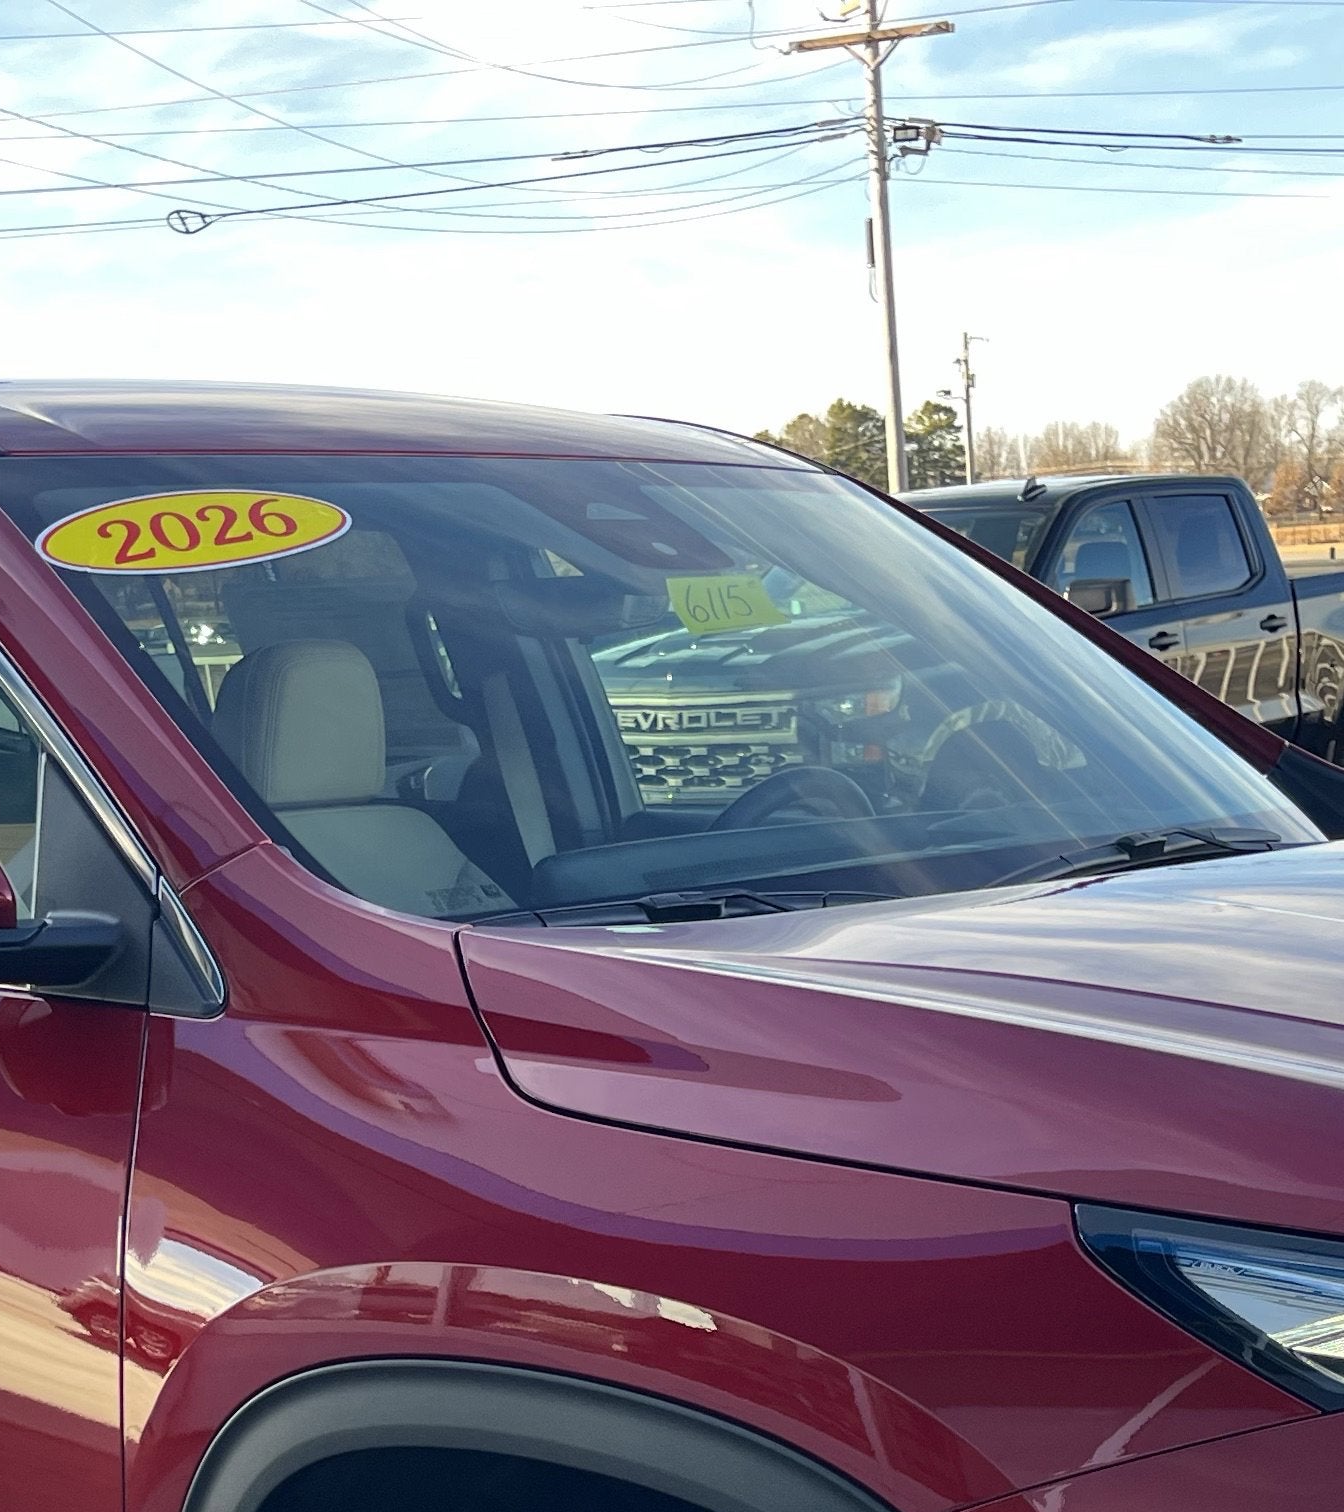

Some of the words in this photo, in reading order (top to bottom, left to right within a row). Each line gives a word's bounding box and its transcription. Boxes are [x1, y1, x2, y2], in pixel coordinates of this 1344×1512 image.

[96, 498, 298, 565] 2026
[685, 584, 754, 624] 6115
[616, 708, 789, 731] EVROLET
